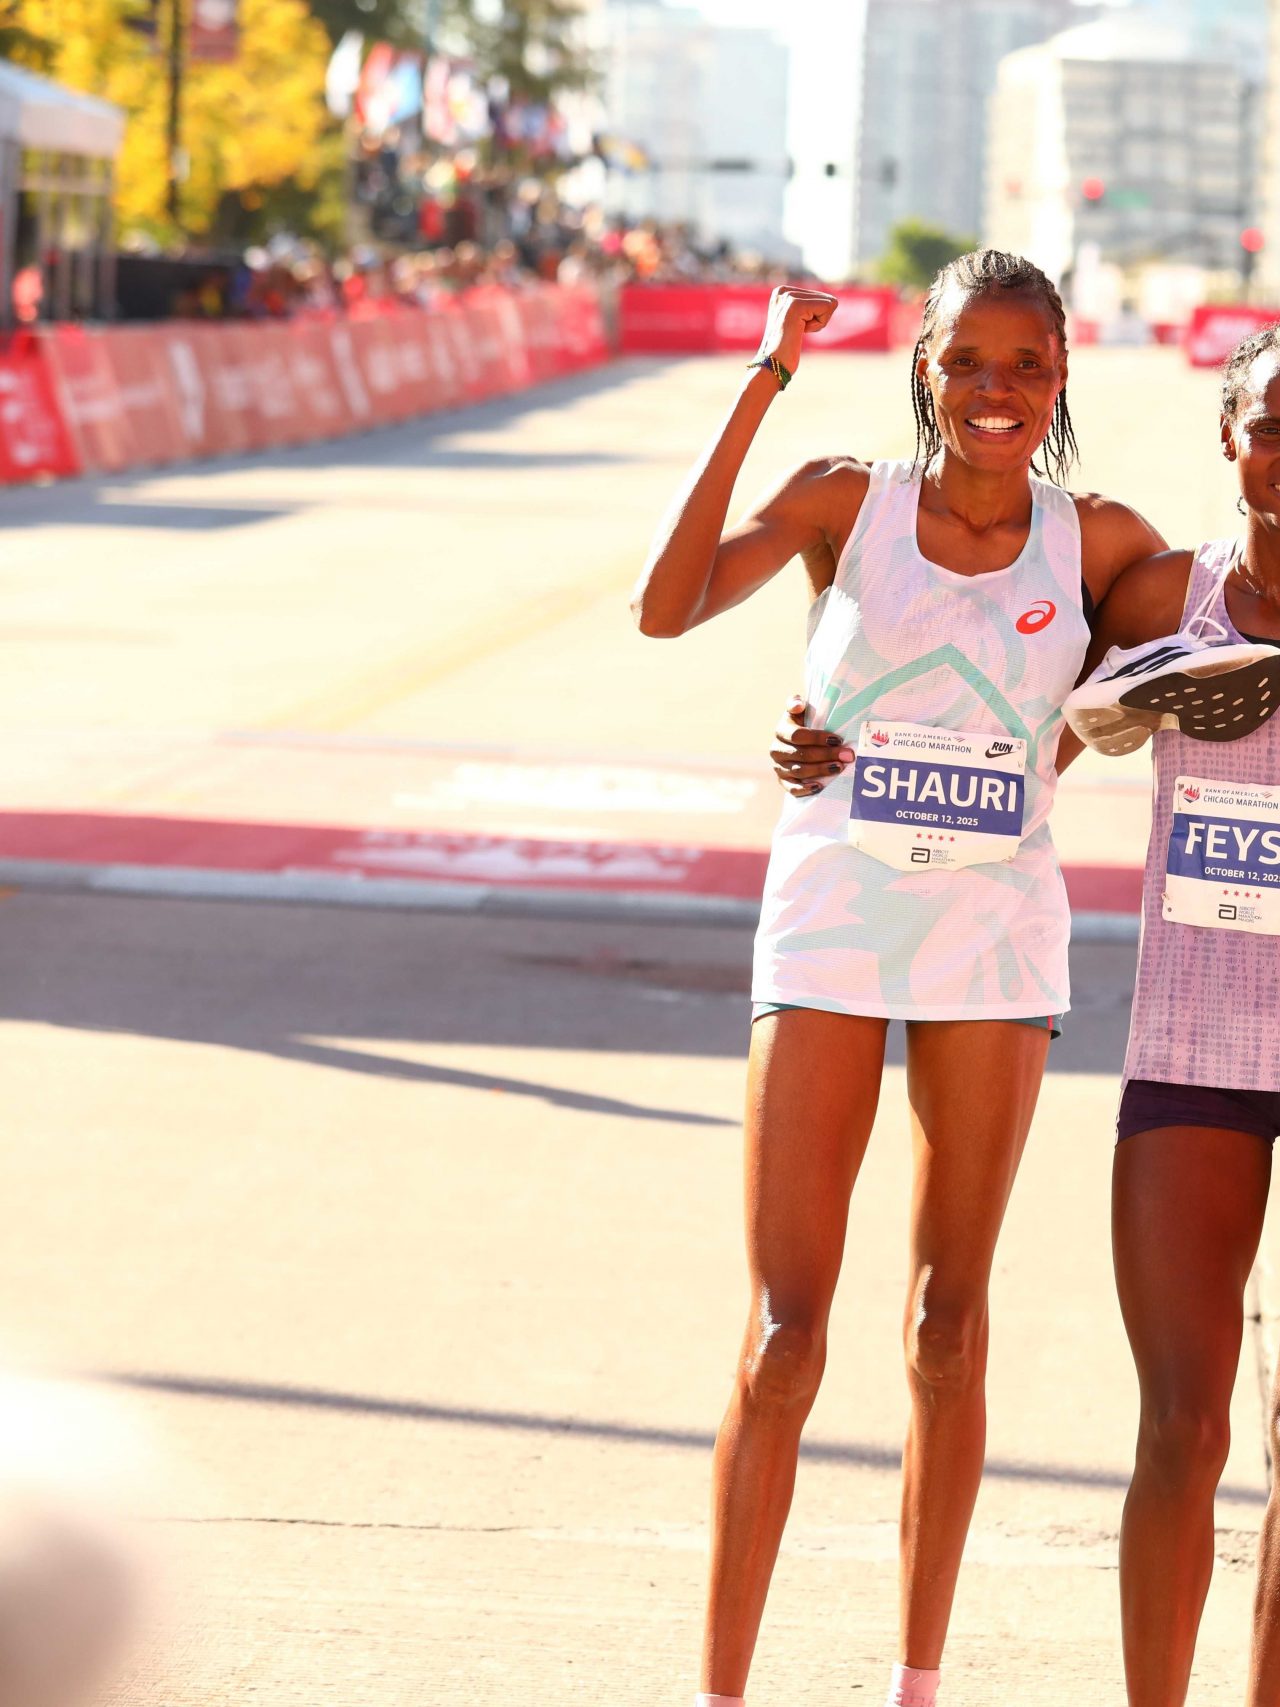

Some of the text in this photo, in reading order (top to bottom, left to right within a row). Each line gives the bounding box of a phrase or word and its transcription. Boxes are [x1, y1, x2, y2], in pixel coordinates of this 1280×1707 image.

[893, 739, 972, 753] CHICAGO MARATHON
[991, 742, 1013, 753] RUN
[861, 765, 1017, 812] SHAURI
[1203, 795, 1279, 809] CHICAGO MARATHON
[896, 810, 979, 826] OCTOBER 12, 2025
[1204, 866, 1245, 878] OCTOBER
[1247, 871, 1260, 882] 12,
